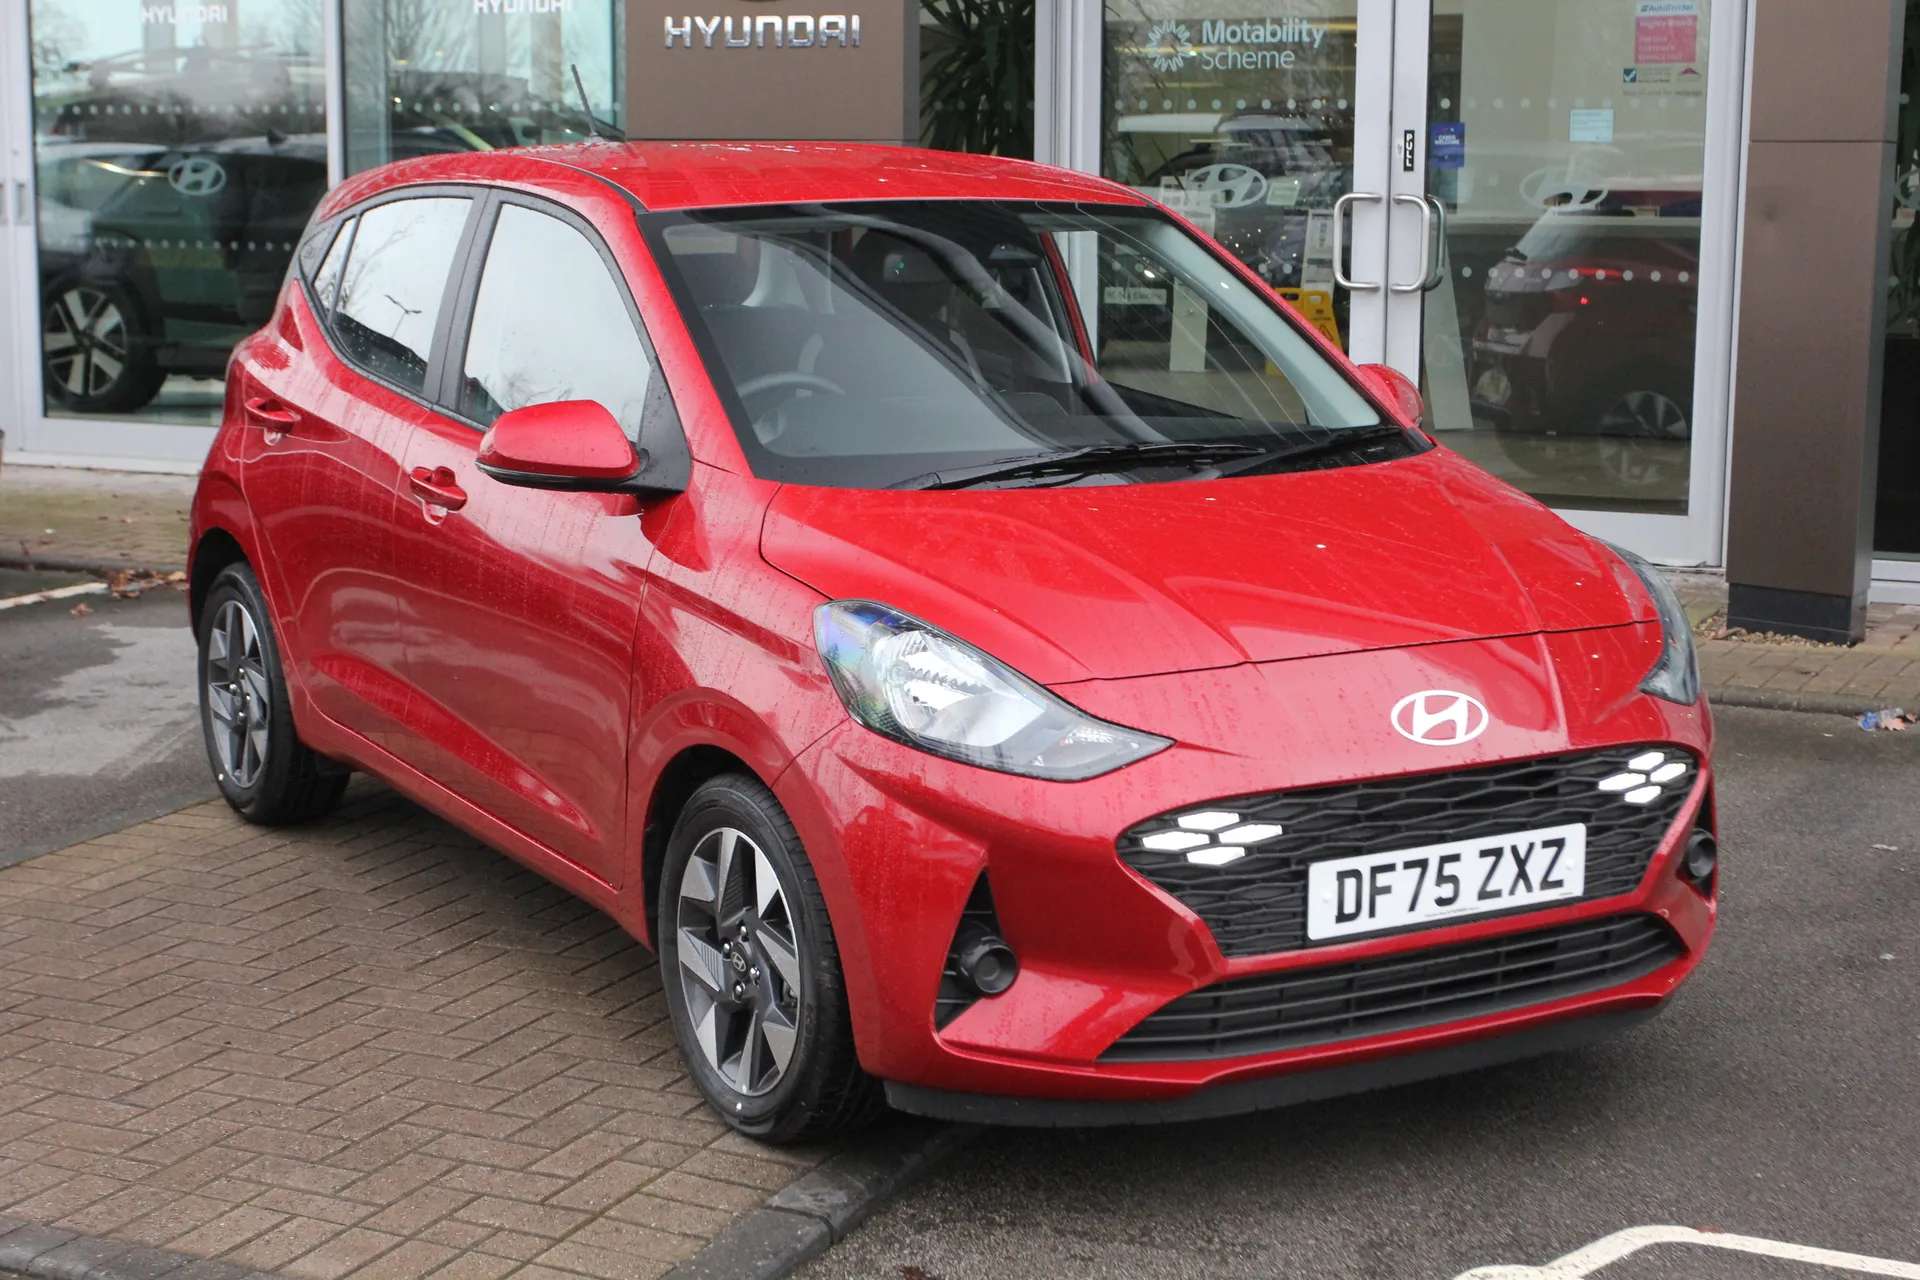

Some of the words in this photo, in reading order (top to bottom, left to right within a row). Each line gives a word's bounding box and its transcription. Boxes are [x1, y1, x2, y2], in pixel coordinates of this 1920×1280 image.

[664, 15, 860, 48] HYUNDAI
[1202, 17, 1326, 48] Motability
[1202, 47, 1295, 70] Scheme
[1405, 132, 1413, 167] PULL
[1335, 853, 1461, 923] DF75
[1478, 837, 1566, 901] ZXZ
